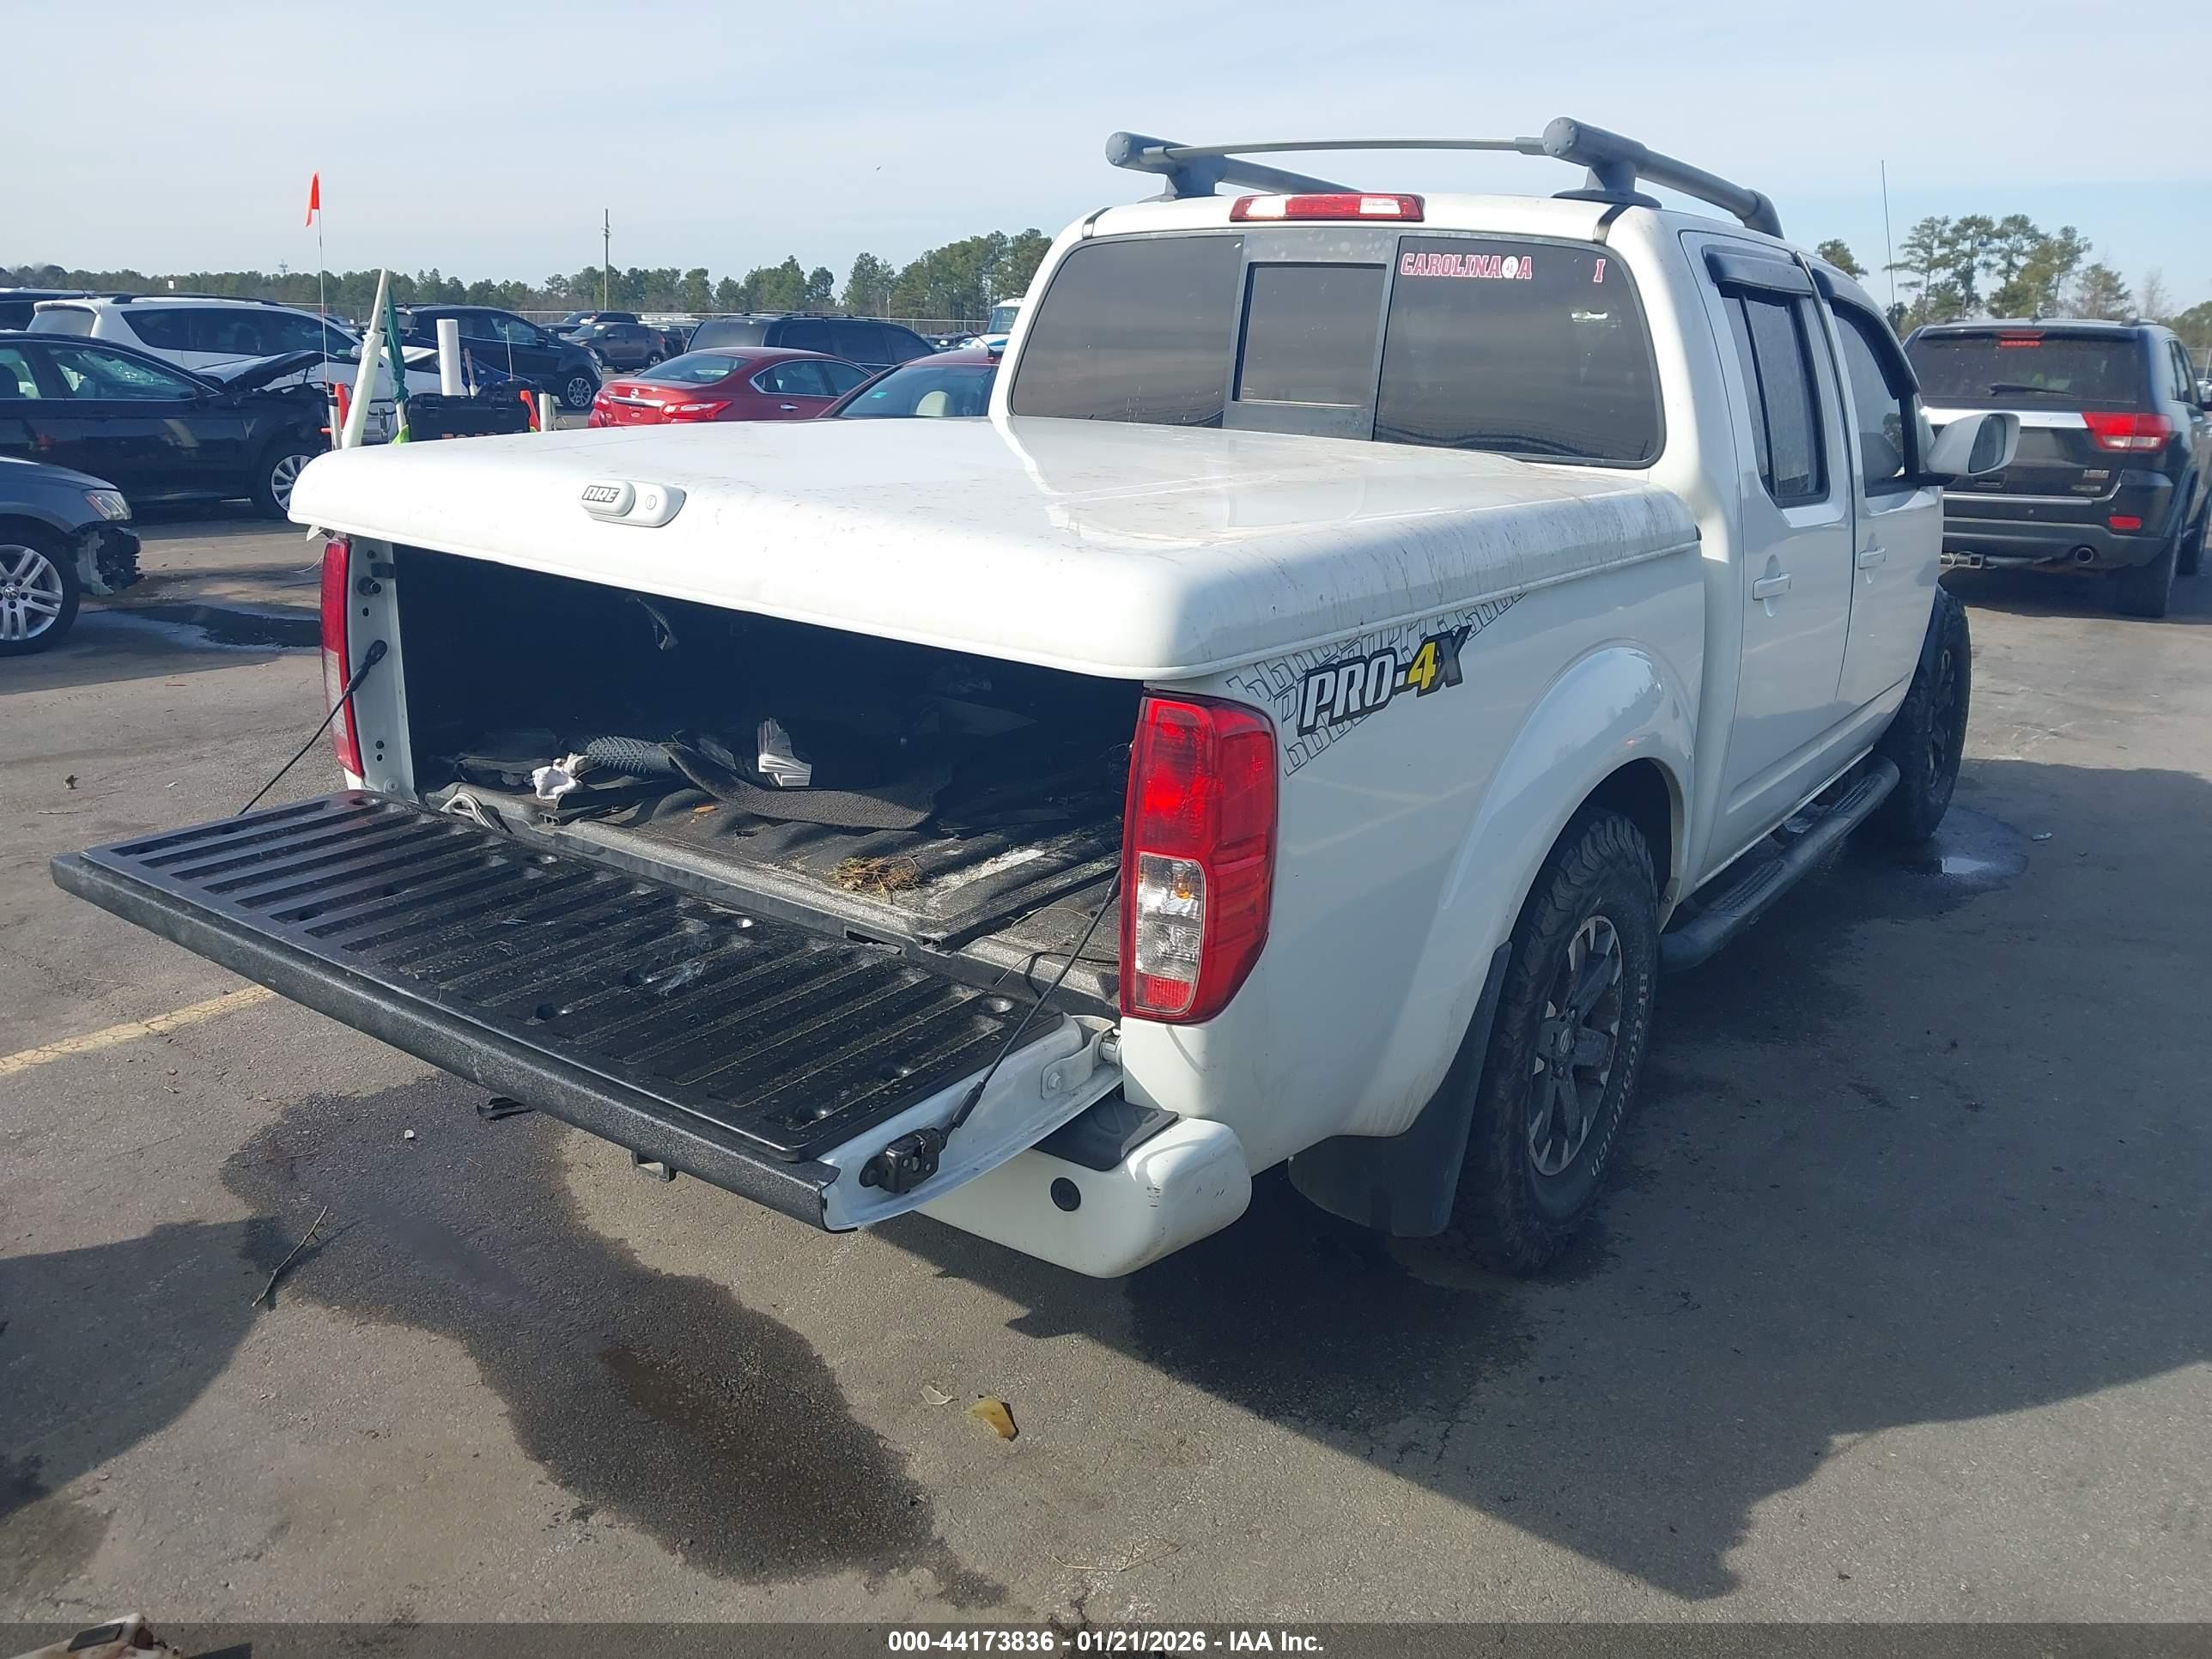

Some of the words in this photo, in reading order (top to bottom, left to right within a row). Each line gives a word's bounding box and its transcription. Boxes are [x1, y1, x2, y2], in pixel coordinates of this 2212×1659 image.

[1401, 253, 1502, 278] CAROLINA
[582, 485, 620, 502] ARE
[1298, 625, 1472, 736] PRO-4X
